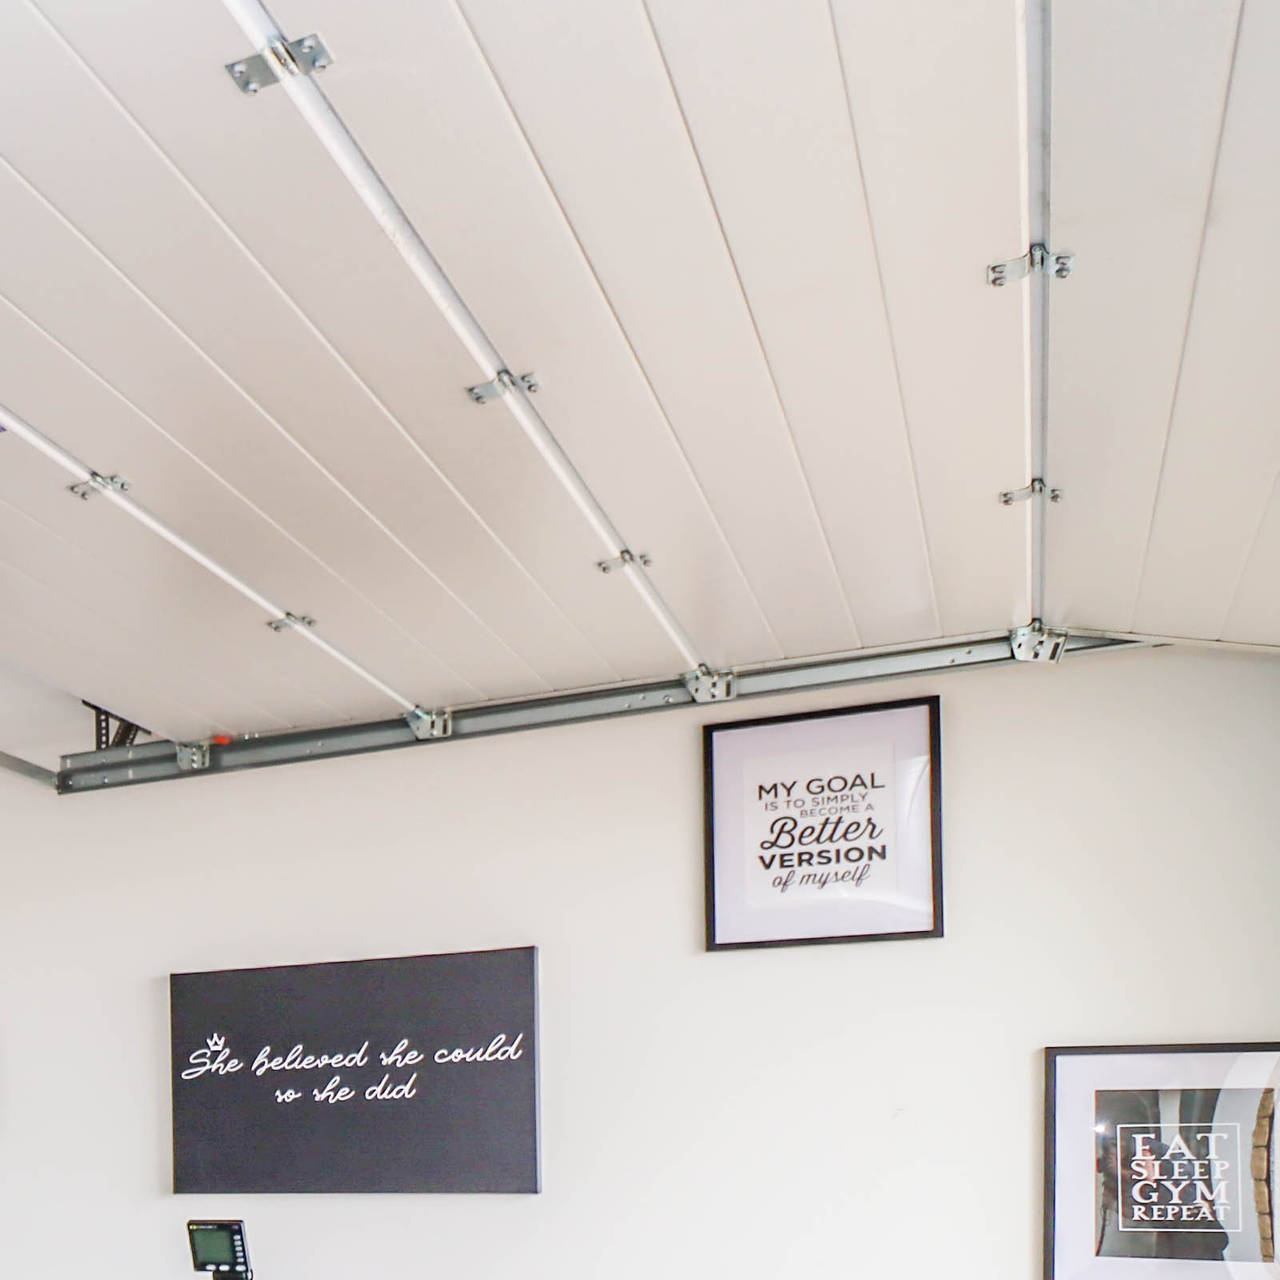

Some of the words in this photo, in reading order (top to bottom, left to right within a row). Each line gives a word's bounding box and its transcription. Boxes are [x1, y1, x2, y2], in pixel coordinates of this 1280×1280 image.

[758, 781, 797, 800] MY
[806, 772, 885, 795] GOAL
[764, 802, 778, 811] IS
[784, 798, 805, 809] TO
[811, 792, 868, 807] SIMPLY
[800, 804, 860, 818] BECOME
[864, 803, 874, 811] A
[760, 816, 883, 850] Better
[758, 844, 886, 870] VERSION
[772, 870, 796, 893] of
[800, 863, 870, 890] myself
[181, 1047, 244, 1080] She
[251, 1040, 369, 1076] believed
[379, 1039, 423, 1068] she
[434, 1032, 523, 1064] could
[275, 1087, 301, 1103] so
[312, 1075, 355, 1104] she
[365, 1073, 417, 1101] did
[1130, 1133, 1229, 1161] EAT
[1130, 1160, 1230, 1181] SLEEP
[1131, 1180, 1230, 1204] GYM
[1132, 1205, 1231, 1221] REPEAT
